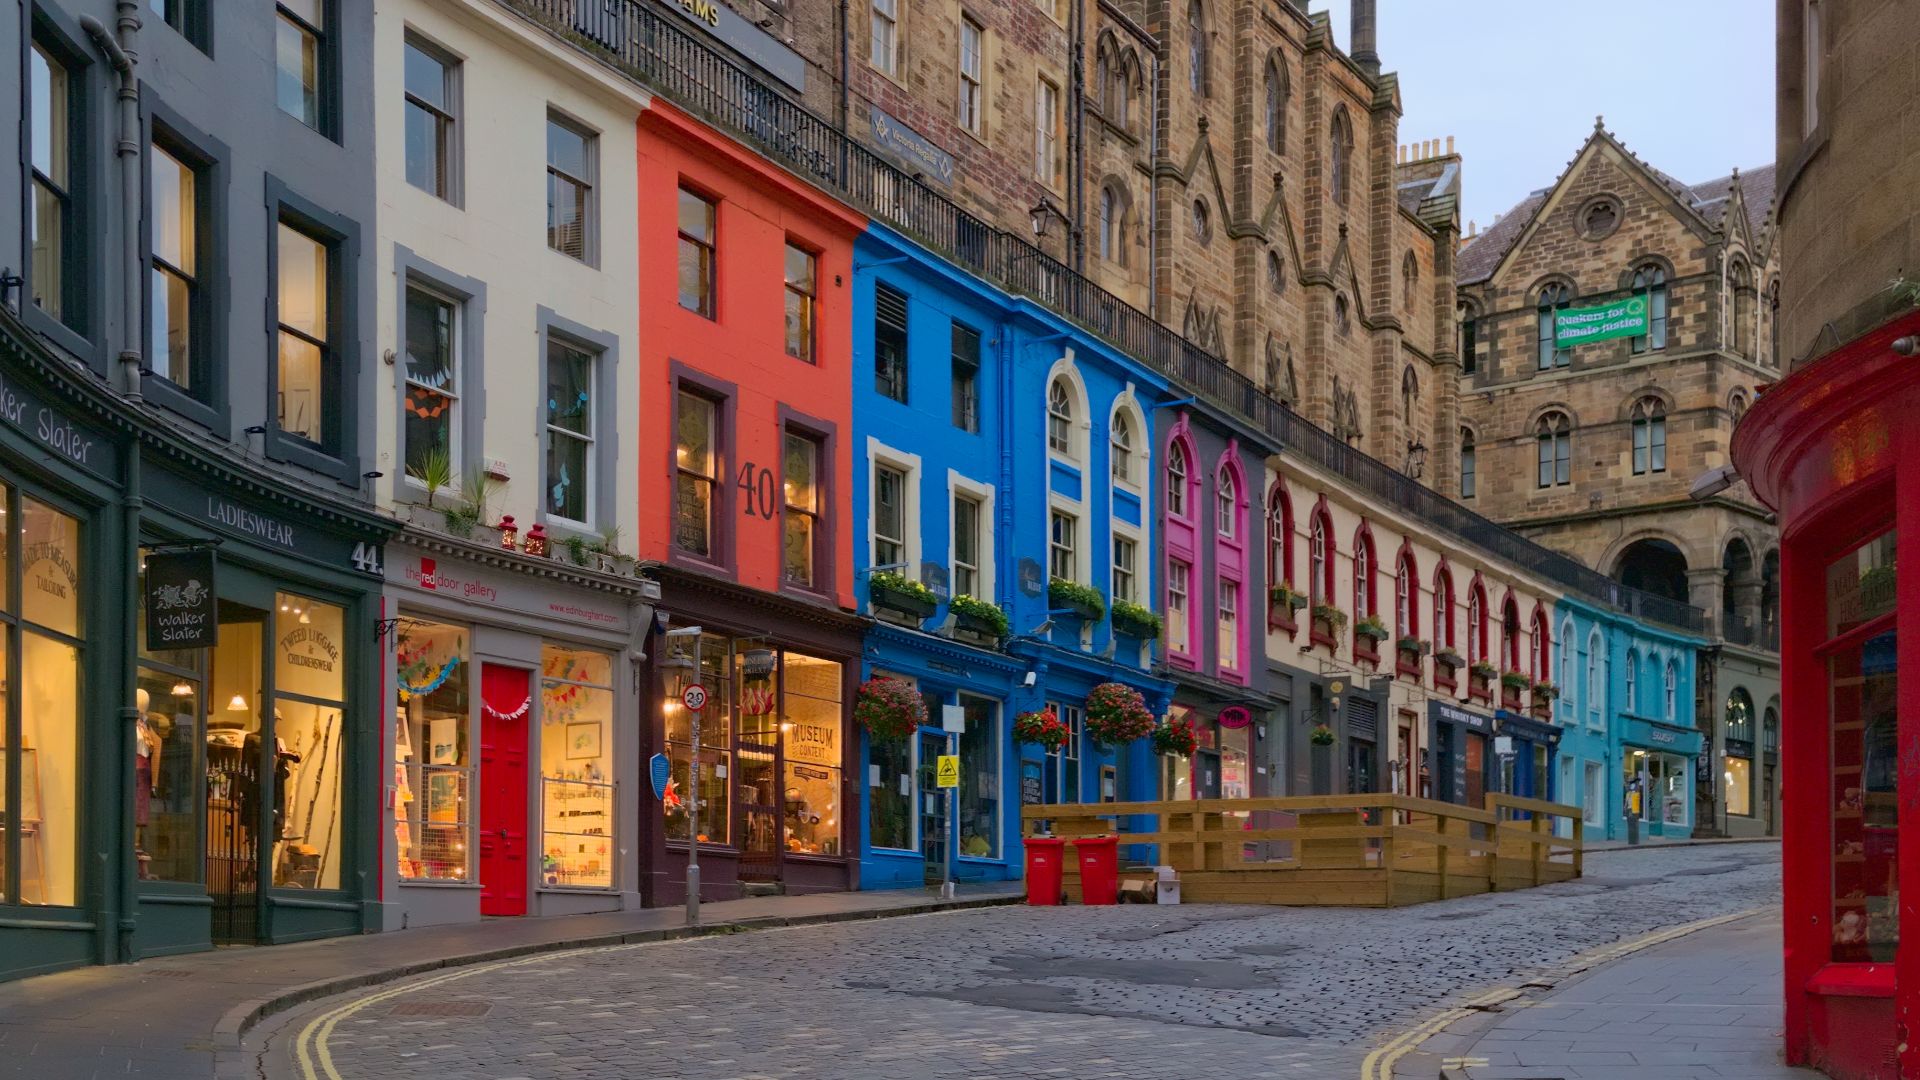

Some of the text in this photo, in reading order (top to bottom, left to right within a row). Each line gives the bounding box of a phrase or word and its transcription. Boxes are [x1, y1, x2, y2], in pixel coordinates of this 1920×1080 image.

[675, 0, 719, 27] AMS
[1557, 307, 1626, 327] Quakers for
[1558, 316, 1643, 339] climate justice
[38, 407, 92, 463] Slater
[737, 461, 775, 521] 40
[208, 497, 293, 547] LADIESWEAR
[39, 541, 50, 560] TO
[36, 574, 67, 600] TAILORING
[405, 563, 498, 602] the red door gallery
[548, 602, 620, 623] www.edinburghart.com
[280, 627, 340, 664] TWEED LUGGAGE
[287, 652, 333, 673] CHILDRENSWEAR
[1440, 706, 1484, 728] THE WHISKY SHOP
[791, 723, 833, 750] MUSEUM
[799, 744, 825, 760] CONTEXT
